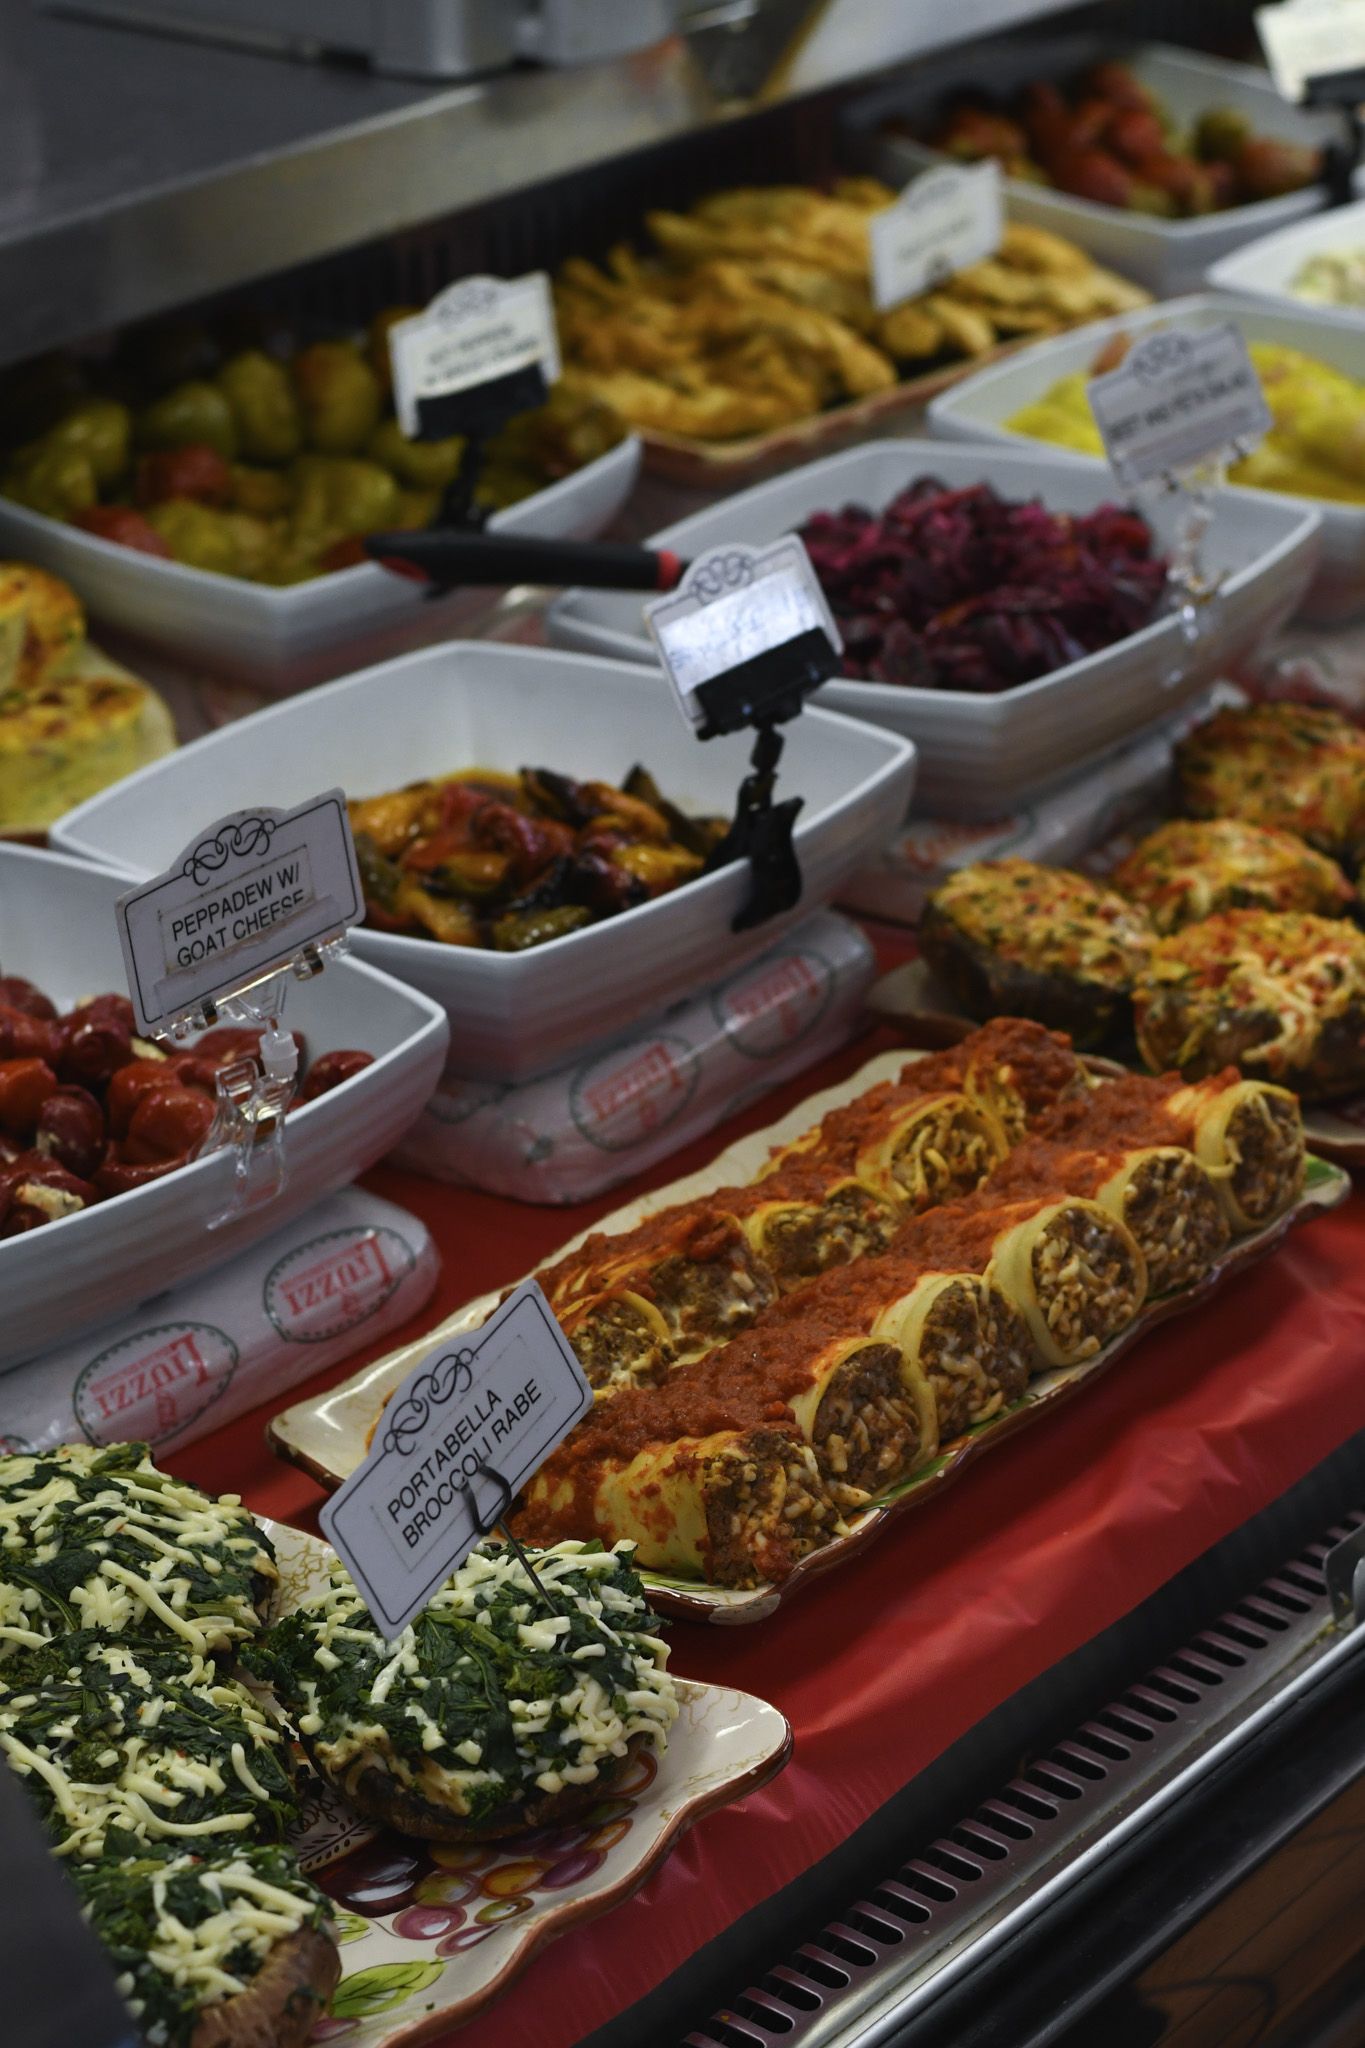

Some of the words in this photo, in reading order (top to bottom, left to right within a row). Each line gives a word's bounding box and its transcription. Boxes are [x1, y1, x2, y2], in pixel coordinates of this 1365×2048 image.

[172, 876, 272, 941] PEPPADEW
[277, 863, 300, 888] W/
[178, 929, 226, 966] GOAT
[98, 1333, 208, 1418] LIUZZI
[387, 1389, 502, 1524] PORTABELLA
[402, 1445, 492, 1548] BROCCOLI
[488, 1379, 542, 1447] RABE
